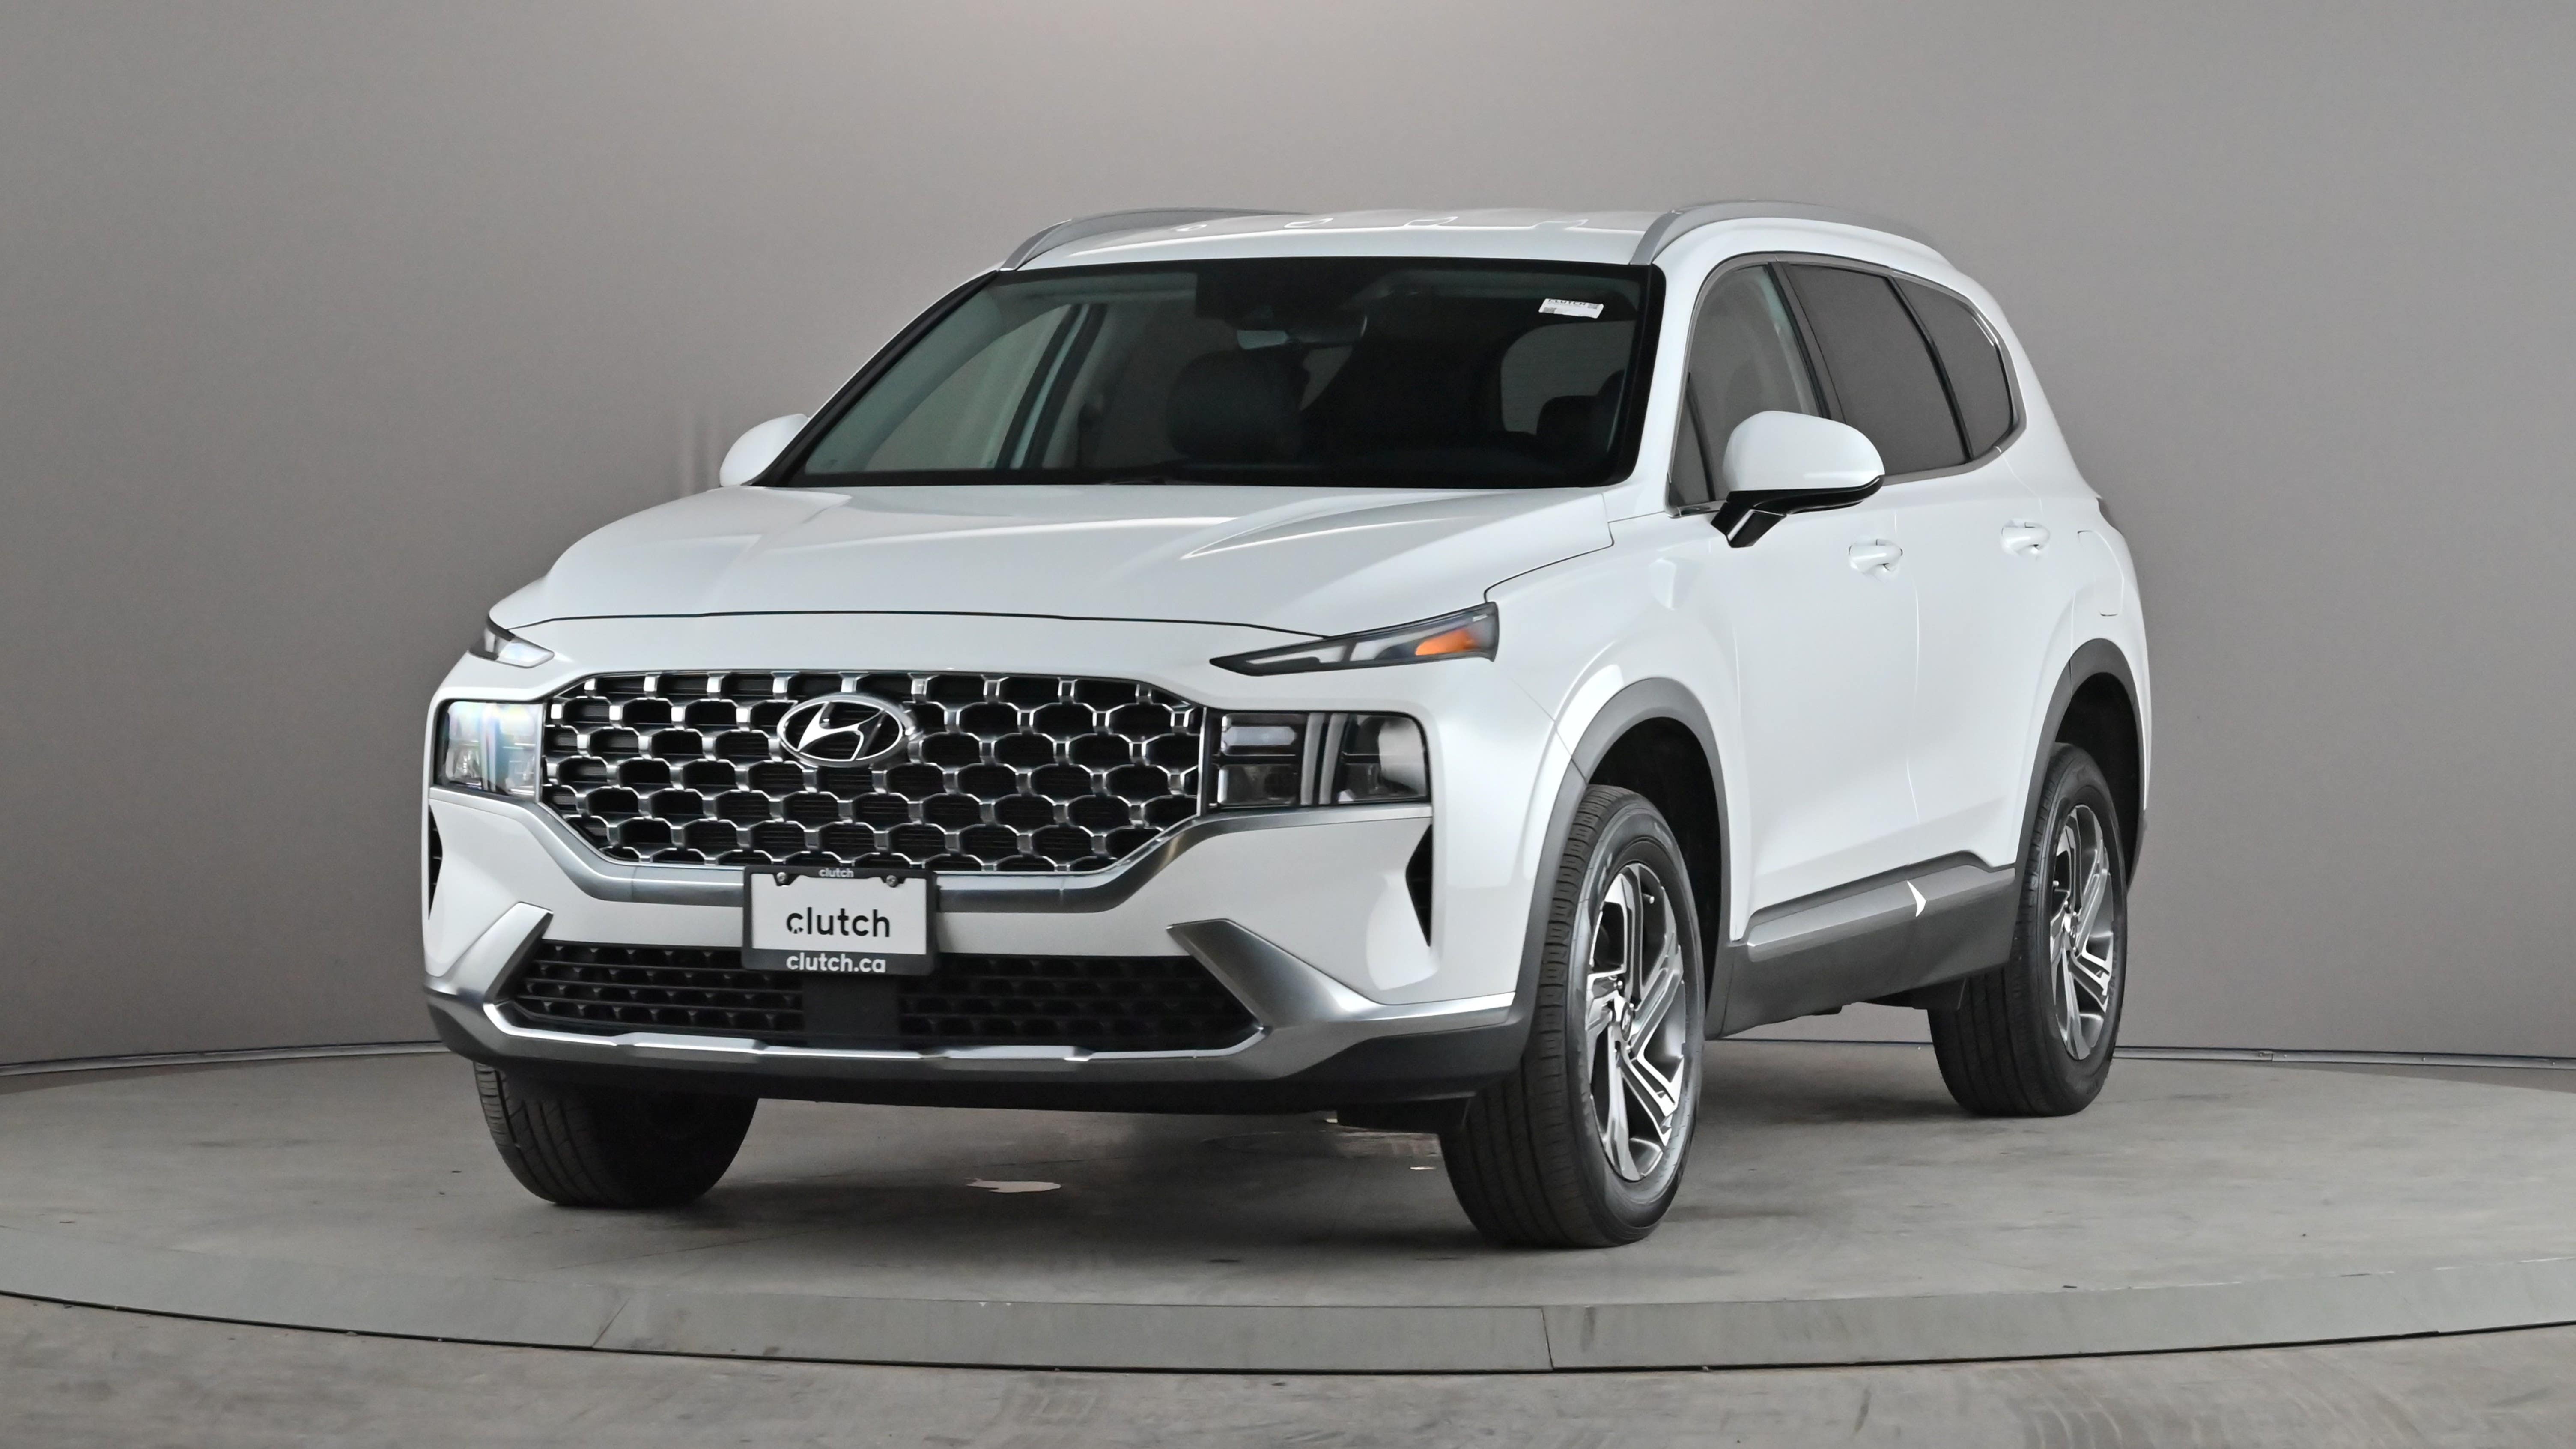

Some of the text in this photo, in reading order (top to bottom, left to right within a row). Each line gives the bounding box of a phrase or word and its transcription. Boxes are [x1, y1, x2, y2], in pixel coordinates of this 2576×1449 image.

[818, 867, 854, 878] clutch
[786, 906, 890, 938] clutch
[786, 952, 886, 973] clutch.ca
